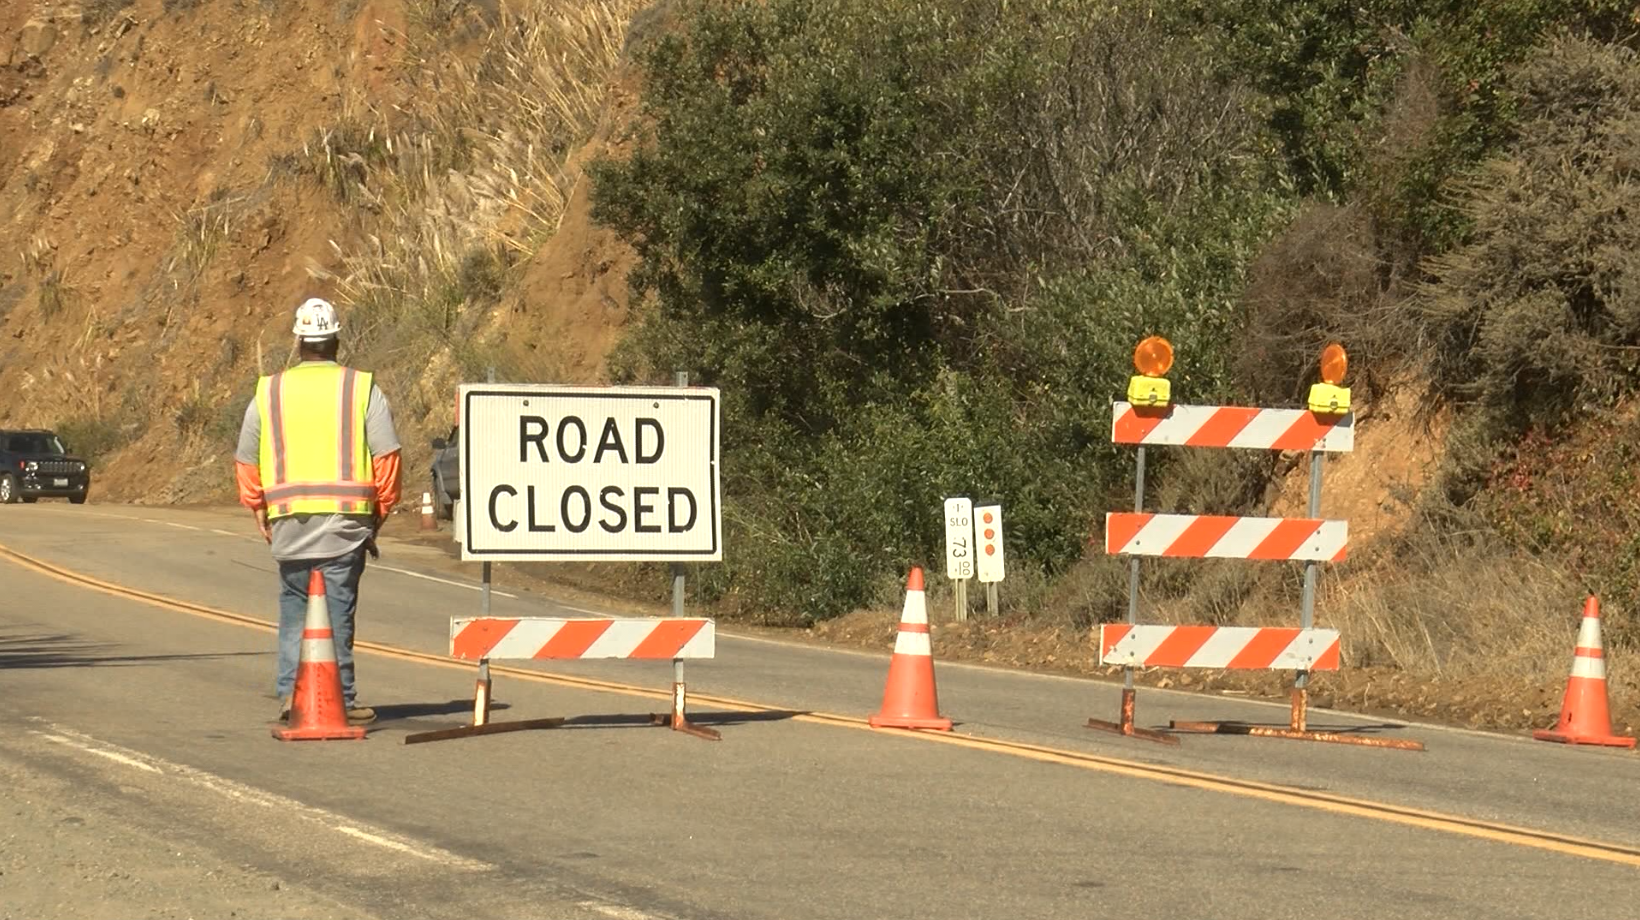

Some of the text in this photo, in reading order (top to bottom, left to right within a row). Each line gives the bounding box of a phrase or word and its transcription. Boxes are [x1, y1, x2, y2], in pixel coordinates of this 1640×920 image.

[316, 314, 328, 330] LA
[520, 415, 665, 464] ROAD
[488, 484, 697, 534] CLOSED
[950, 517, 968, 527] SLO
[952, 539, 967, 558] 73
